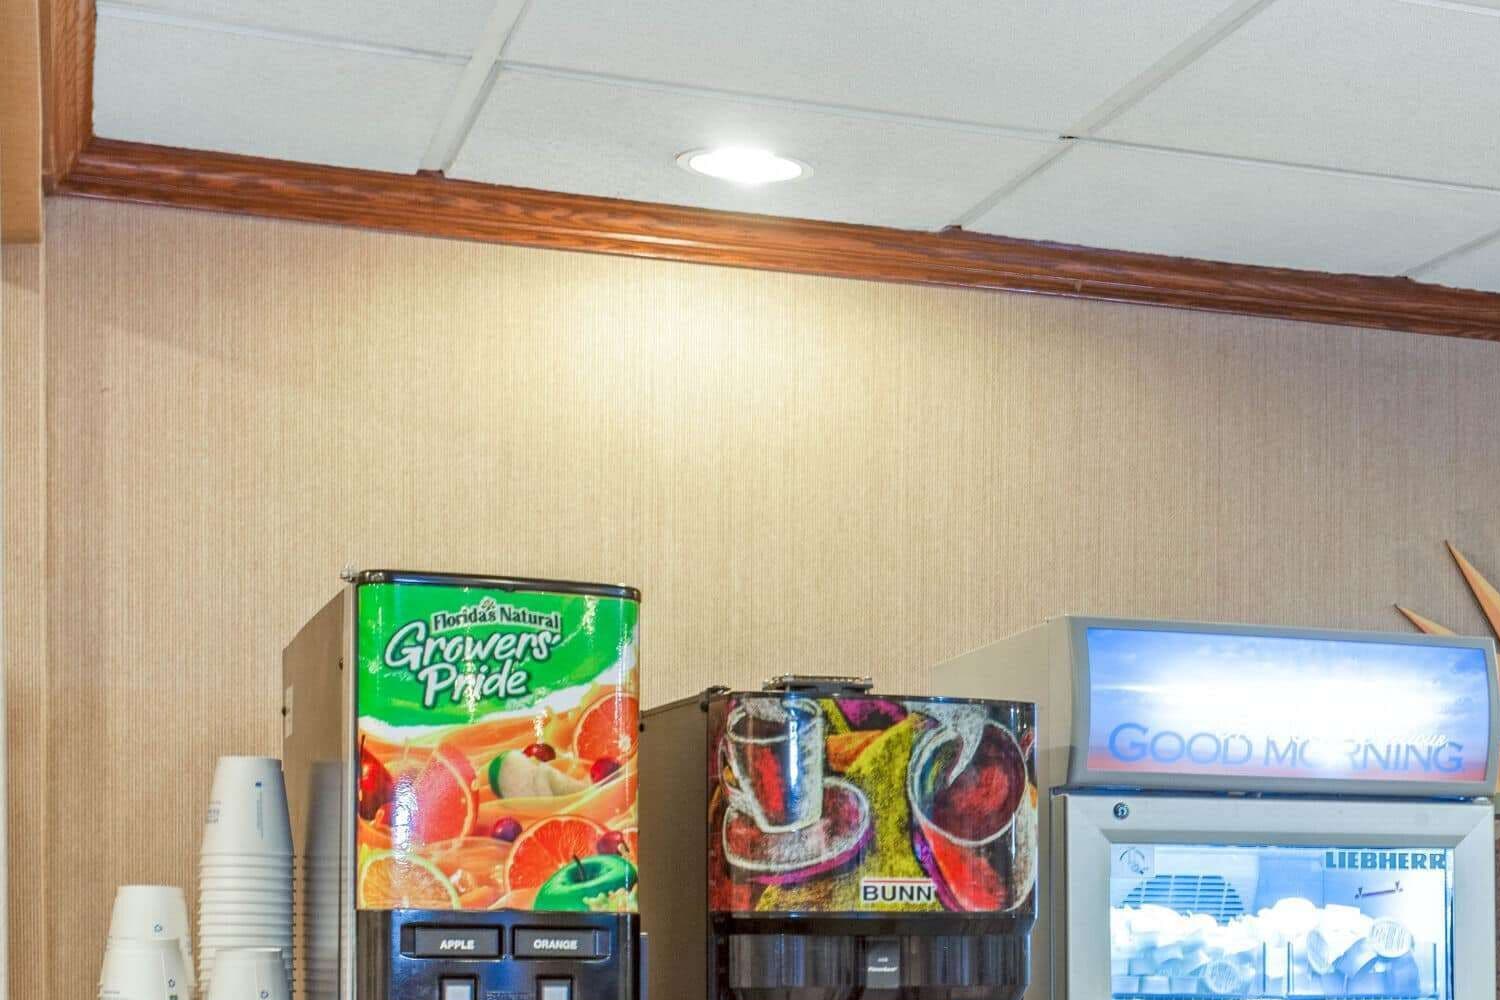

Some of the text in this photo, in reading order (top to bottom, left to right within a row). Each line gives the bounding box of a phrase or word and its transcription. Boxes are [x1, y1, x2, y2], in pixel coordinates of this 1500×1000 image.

[500, 606, 559, 630] Natural
[417, 658, 528, 707] Pride
[1108, 722, 1253, 764] GOOD
[1325, 851, 1446, 870] LIEBHERR
[863, 885, 932, 902] BUNN
[440, 939, 474, 950] APPLE
[533, 938, 578, 950] ORANGE
